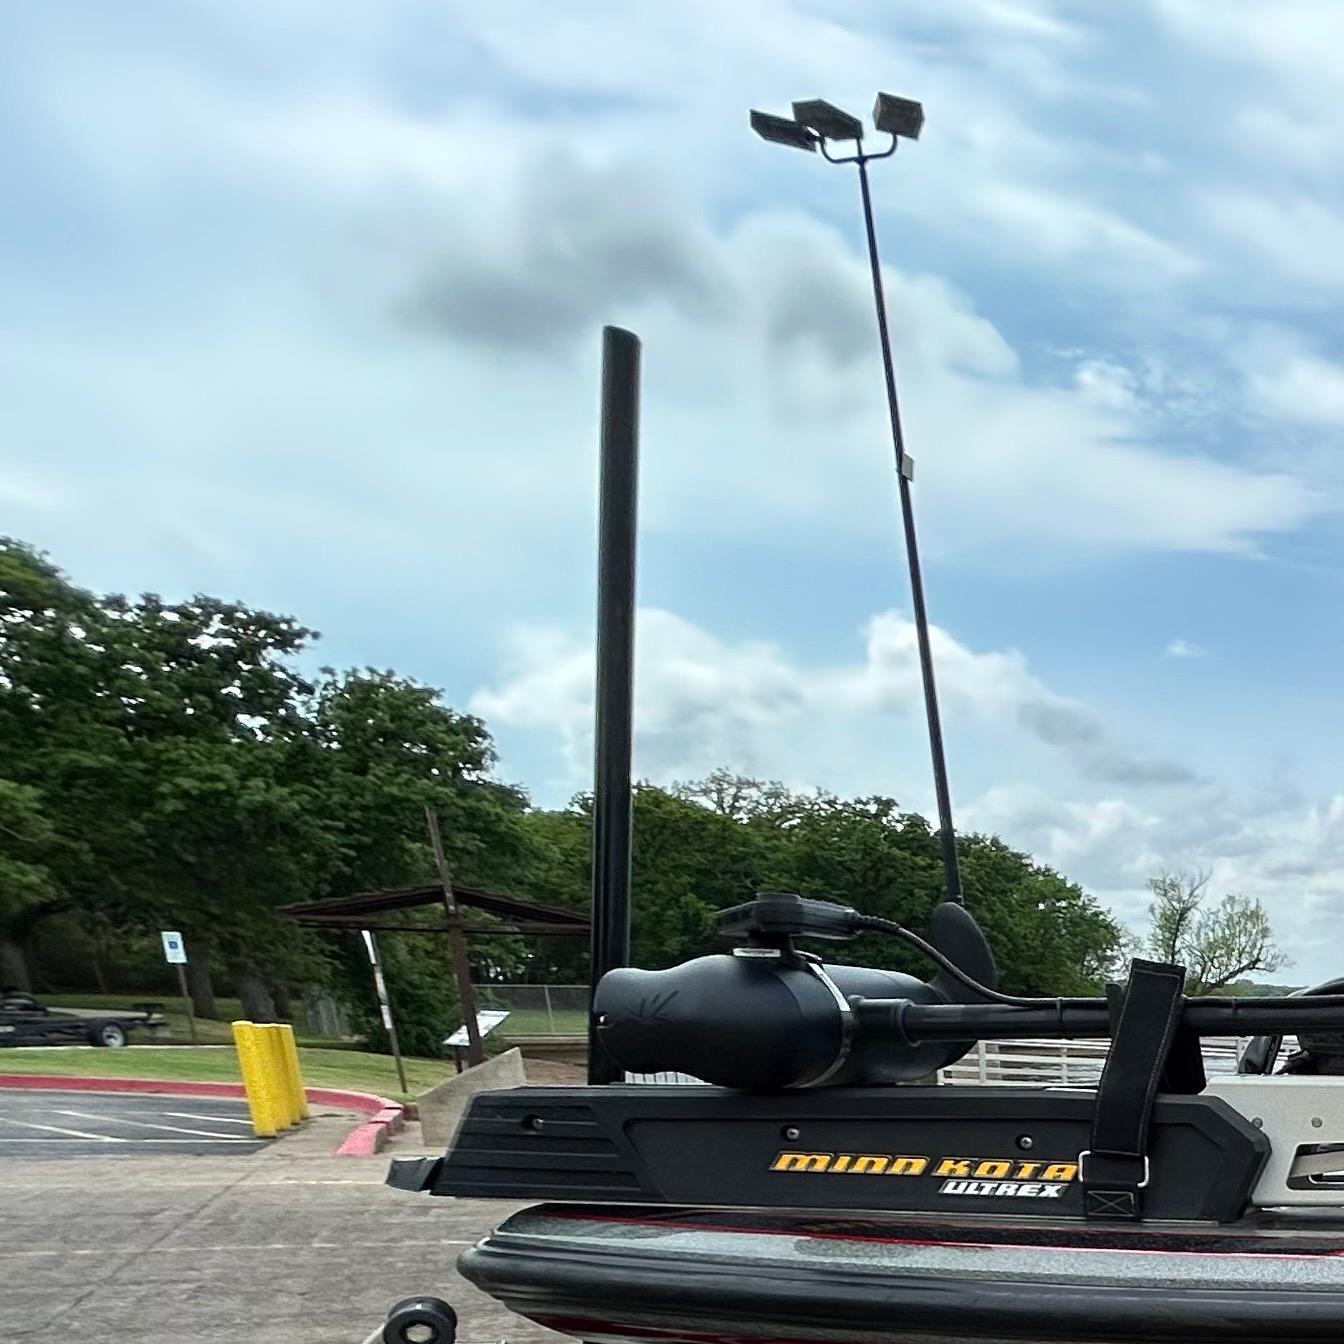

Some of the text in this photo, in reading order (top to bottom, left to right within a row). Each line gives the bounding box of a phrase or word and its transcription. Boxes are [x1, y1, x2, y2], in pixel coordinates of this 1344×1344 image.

[771, 1153, 1079, 1181] MINN KOTA
[941, 1180, 1065, 1198] ULTREX
